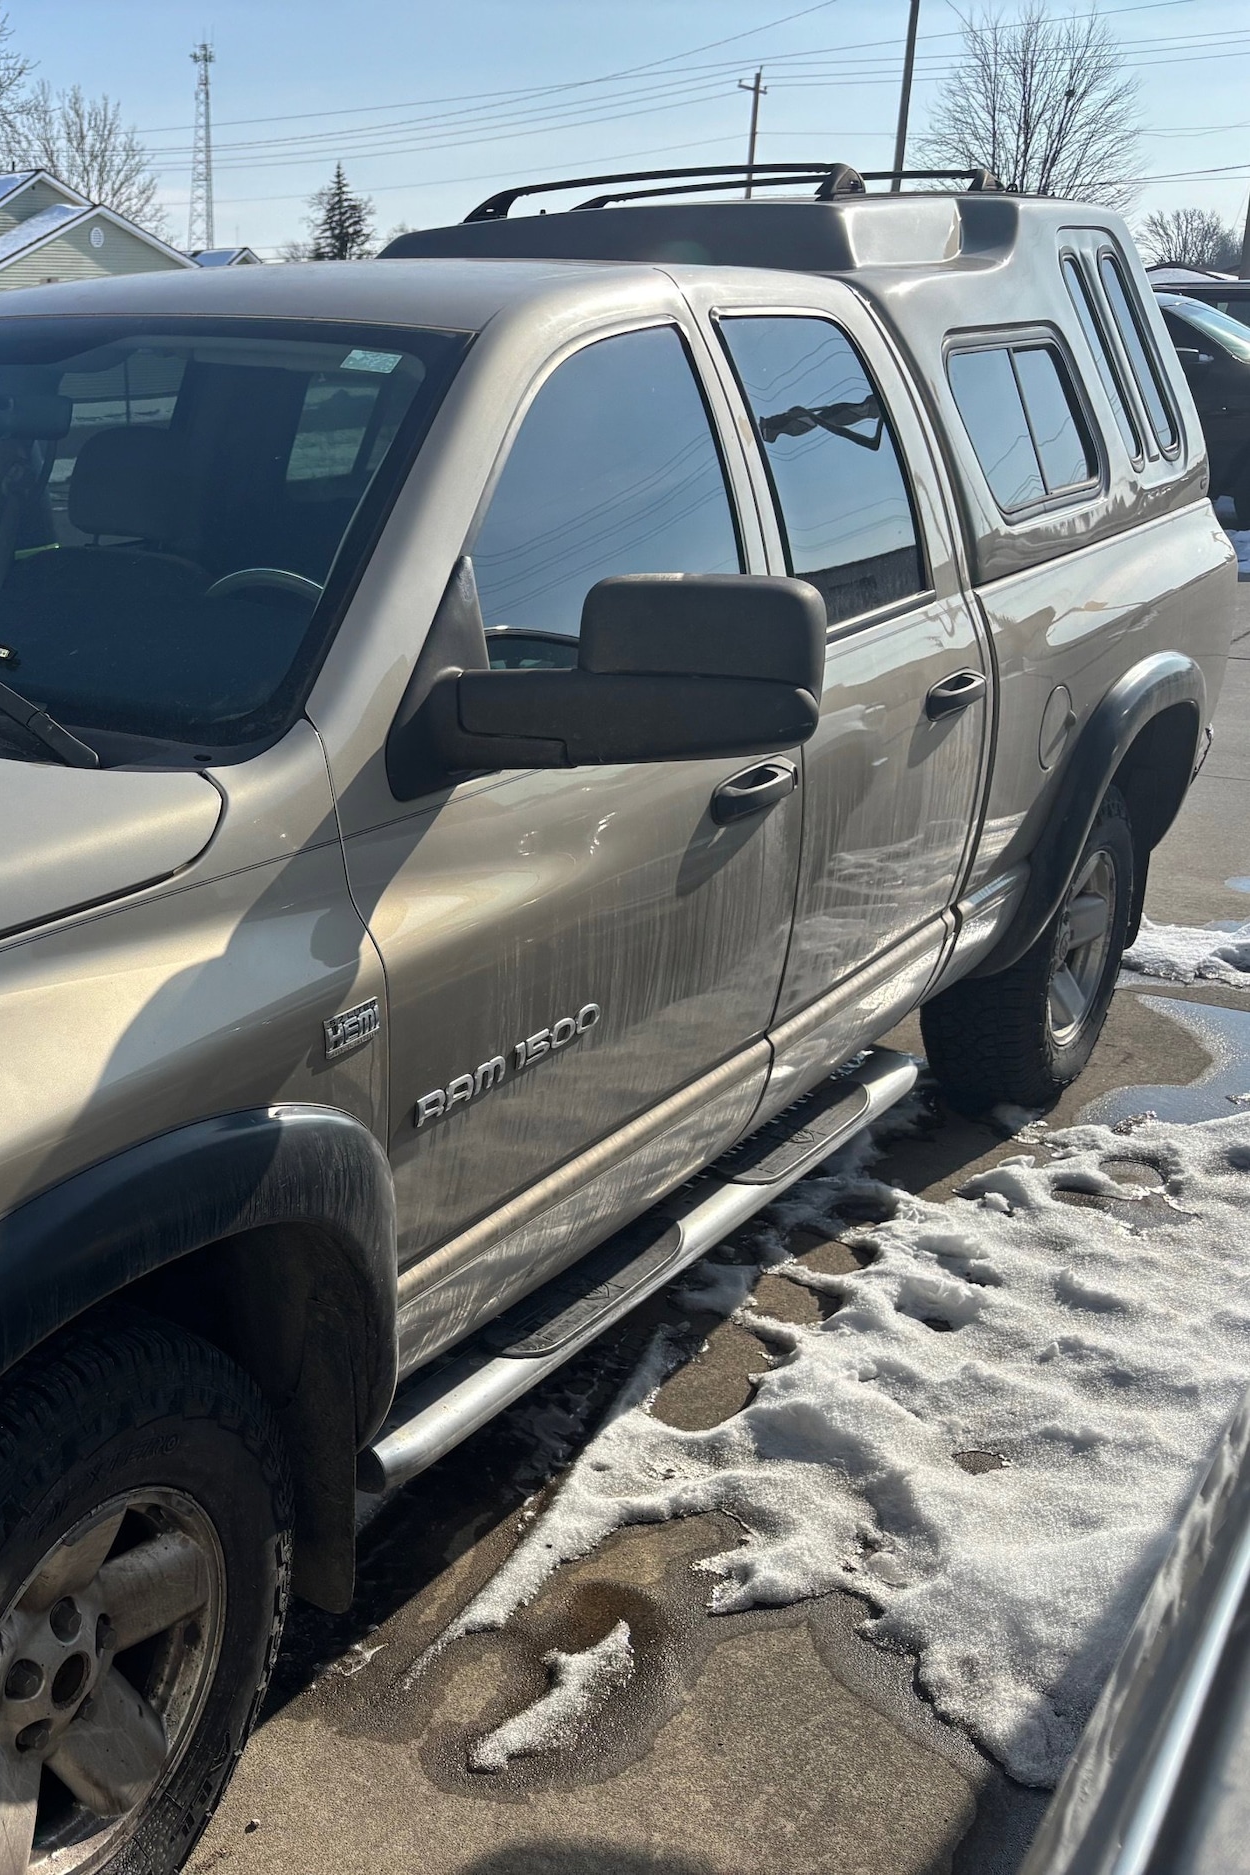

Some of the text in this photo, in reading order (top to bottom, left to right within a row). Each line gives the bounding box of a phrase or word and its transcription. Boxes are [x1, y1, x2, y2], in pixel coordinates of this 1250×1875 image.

[325, 1003, 380, 1052] HEMI
[414, 1003, 600, 1128] RAM 1500
